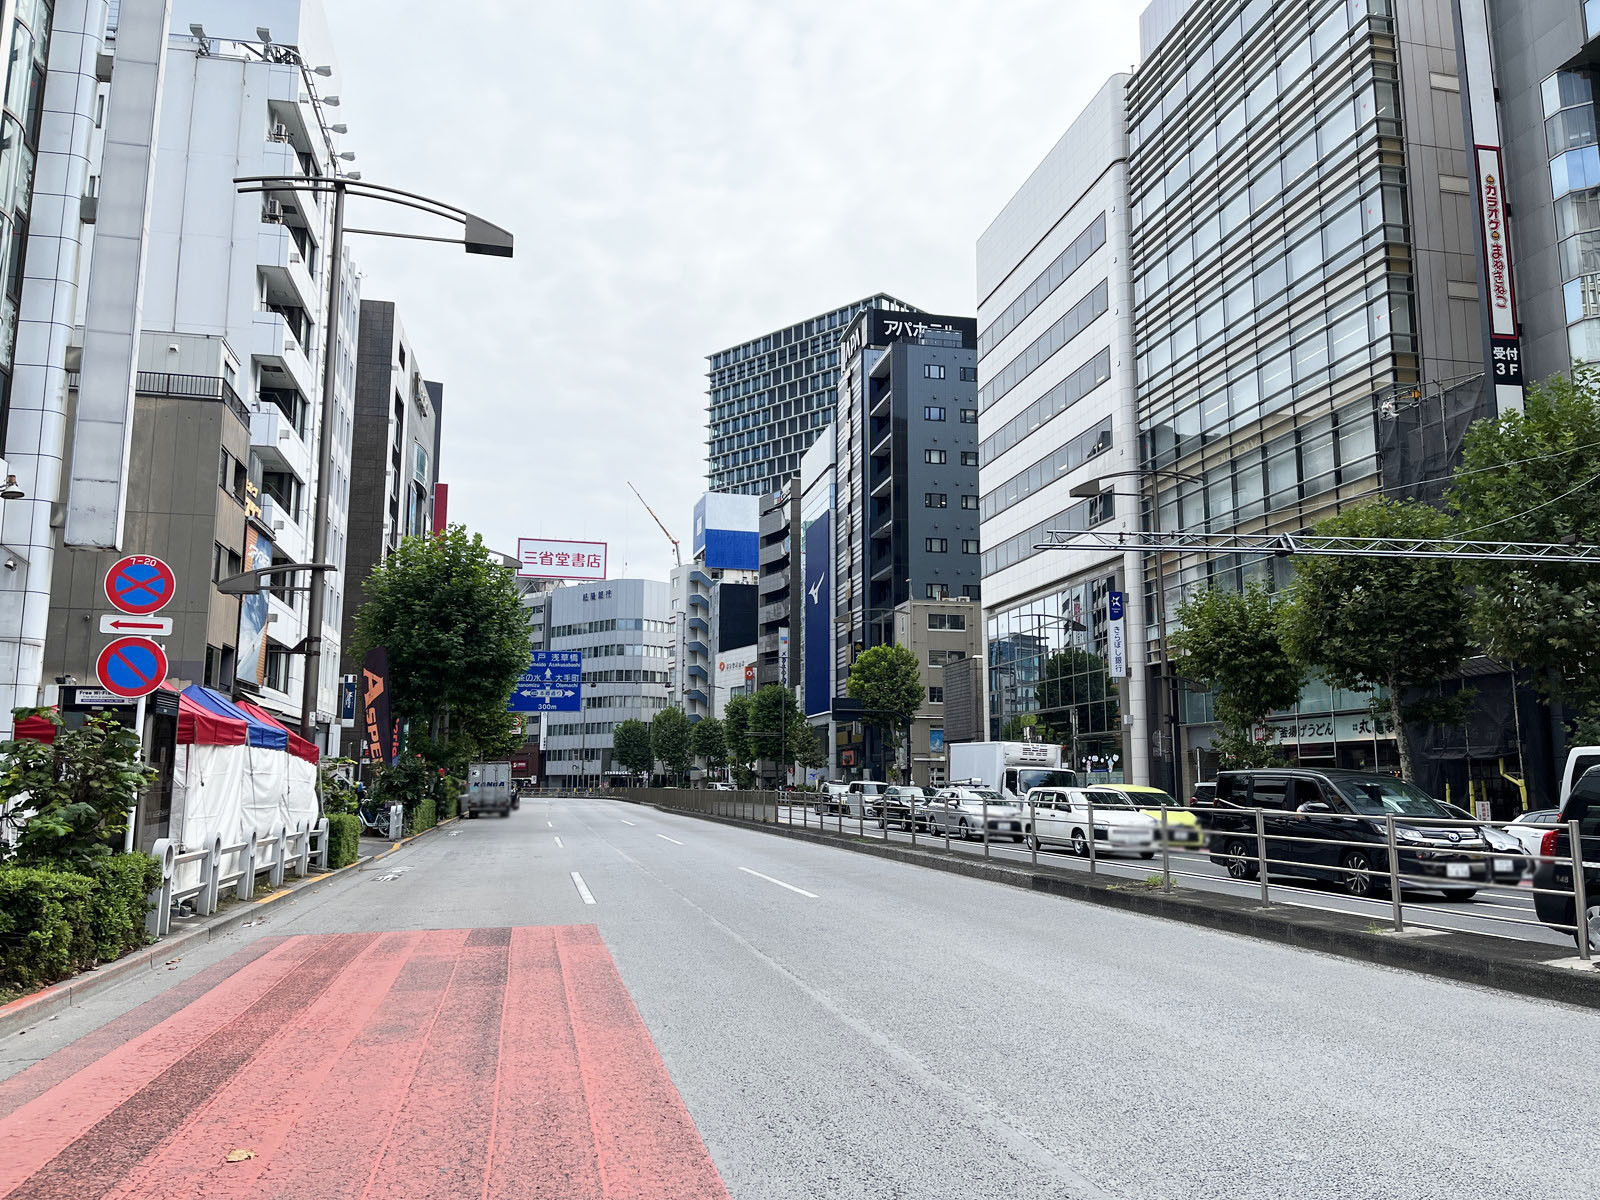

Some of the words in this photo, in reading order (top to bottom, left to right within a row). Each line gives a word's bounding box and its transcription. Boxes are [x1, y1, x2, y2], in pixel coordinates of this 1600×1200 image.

[1485, 184, 1500, 231] カラオケ
[1491, 243, 1508, 310] まねきねこ
[883, 320, 953, 338] アパホ
[1493, 346, 1519, 361] 受付
[130, 557, 157, 567] 7-20
[523, 551, 602, 568] 三省堂書店
[552, 653, 578, 662] 浅草橋
[1114, 626, 1122, 672] きらぼし銀行
[555, 674, 579, 682] 大手町
[363, 667, 384, 763] ASPE
